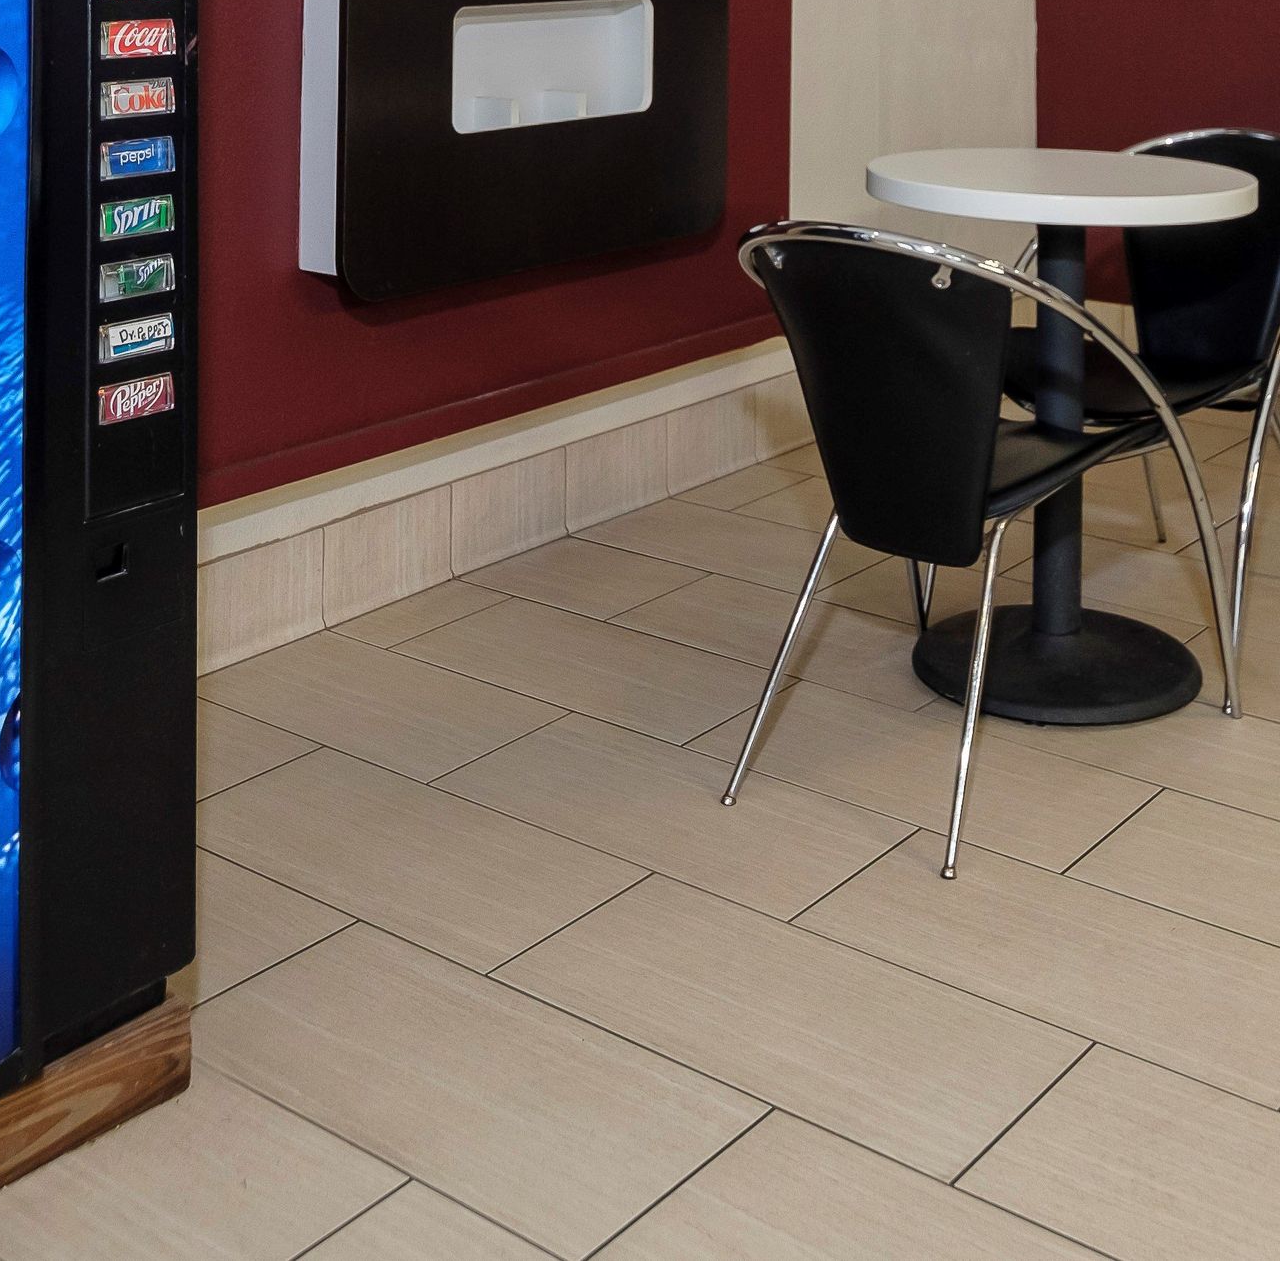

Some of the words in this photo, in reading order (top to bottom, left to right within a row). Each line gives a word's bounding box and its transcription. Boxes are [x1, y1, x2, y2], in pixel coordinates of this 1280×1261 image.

[113, 85, 166, 114] Coke
[120, 143, 155, 166] pepsi
[116, 379, 160, 419] Pepper
